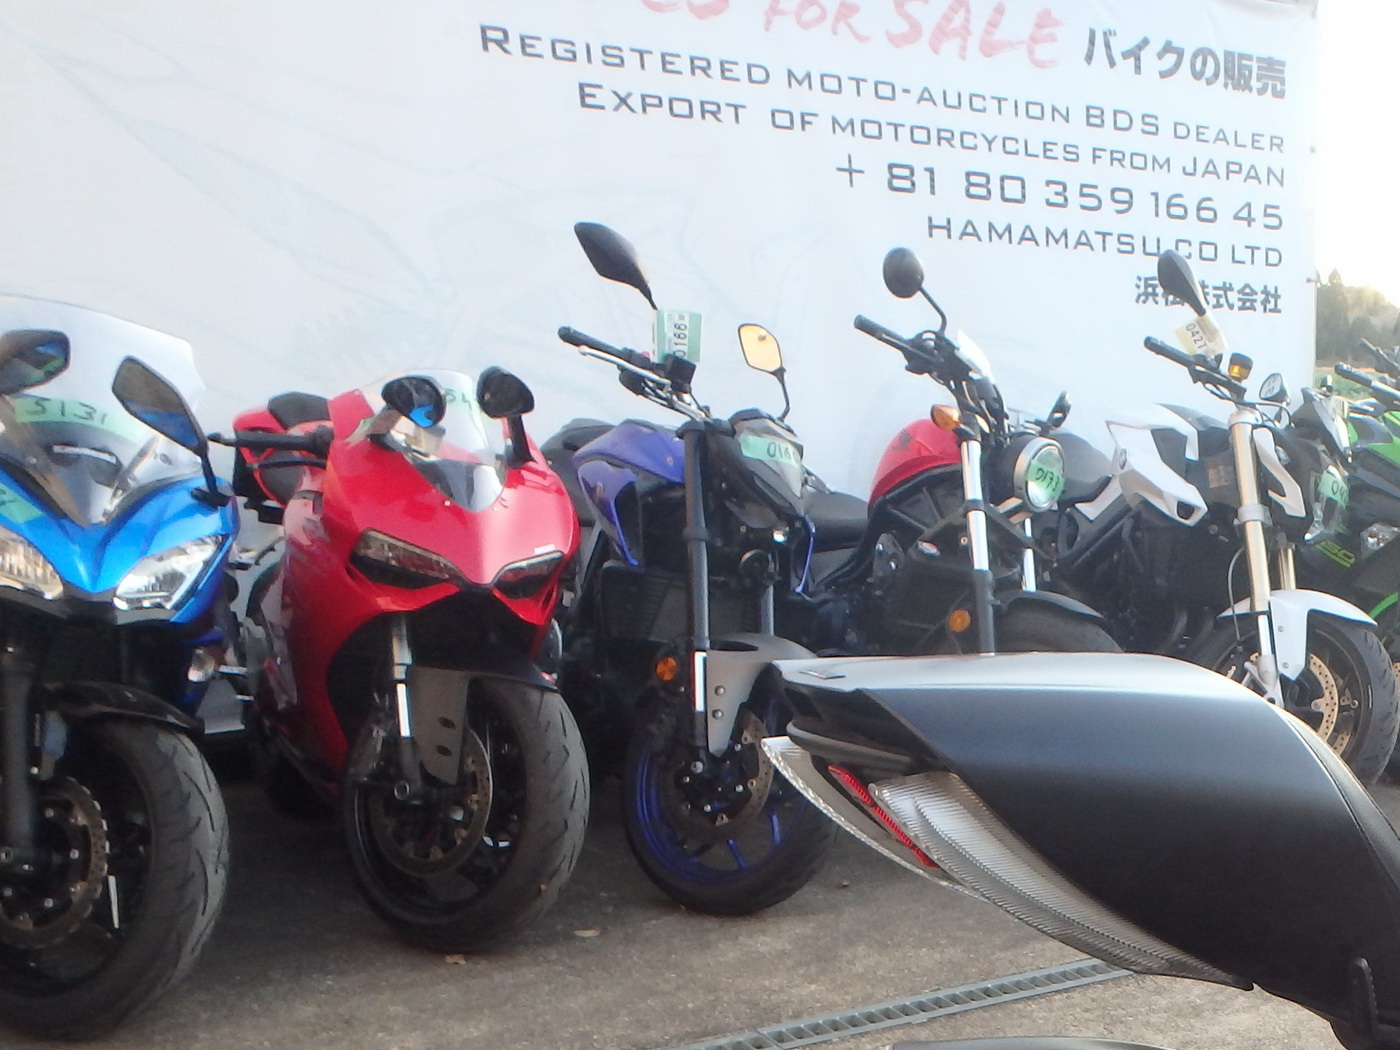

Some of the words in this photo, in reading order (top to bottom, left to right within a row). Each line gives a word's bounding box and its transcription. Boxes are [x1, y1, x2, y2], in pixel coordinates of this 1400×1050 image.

[479, 24, 771, 86] REGISTERED
[786, 67, 1071, 124] MOTO-AUCTION
[1085, 104, 1160, 136] BDS
[1173, 121, 1285, 154] DEALER
[1083, 27, 1287, 99] バイクの販売
[578, 82, 747, 125] EXPORT
[770, 107, 819, 131] OF
[831, 115, 1081, 163] MOTORCYCLES
[1091, 147, 1172, 174] FROM
[1181, 156, 1285, 188] JAPAN
[886, 161, 937, 196] 81
[963, 170, 1027, 205] 80
[1044, 179, 1134, 215] 359
[1150, 191, 1218, 224] 166
[1232, 203, 1284, 231] 45
[927, 215, 1161, 258] HAMAMATSU
[1174, 238, 1218, 262] CO
[1231, 243, 1283, 268] LTD
[1134, 275, 1282, 314] 浜式会社
